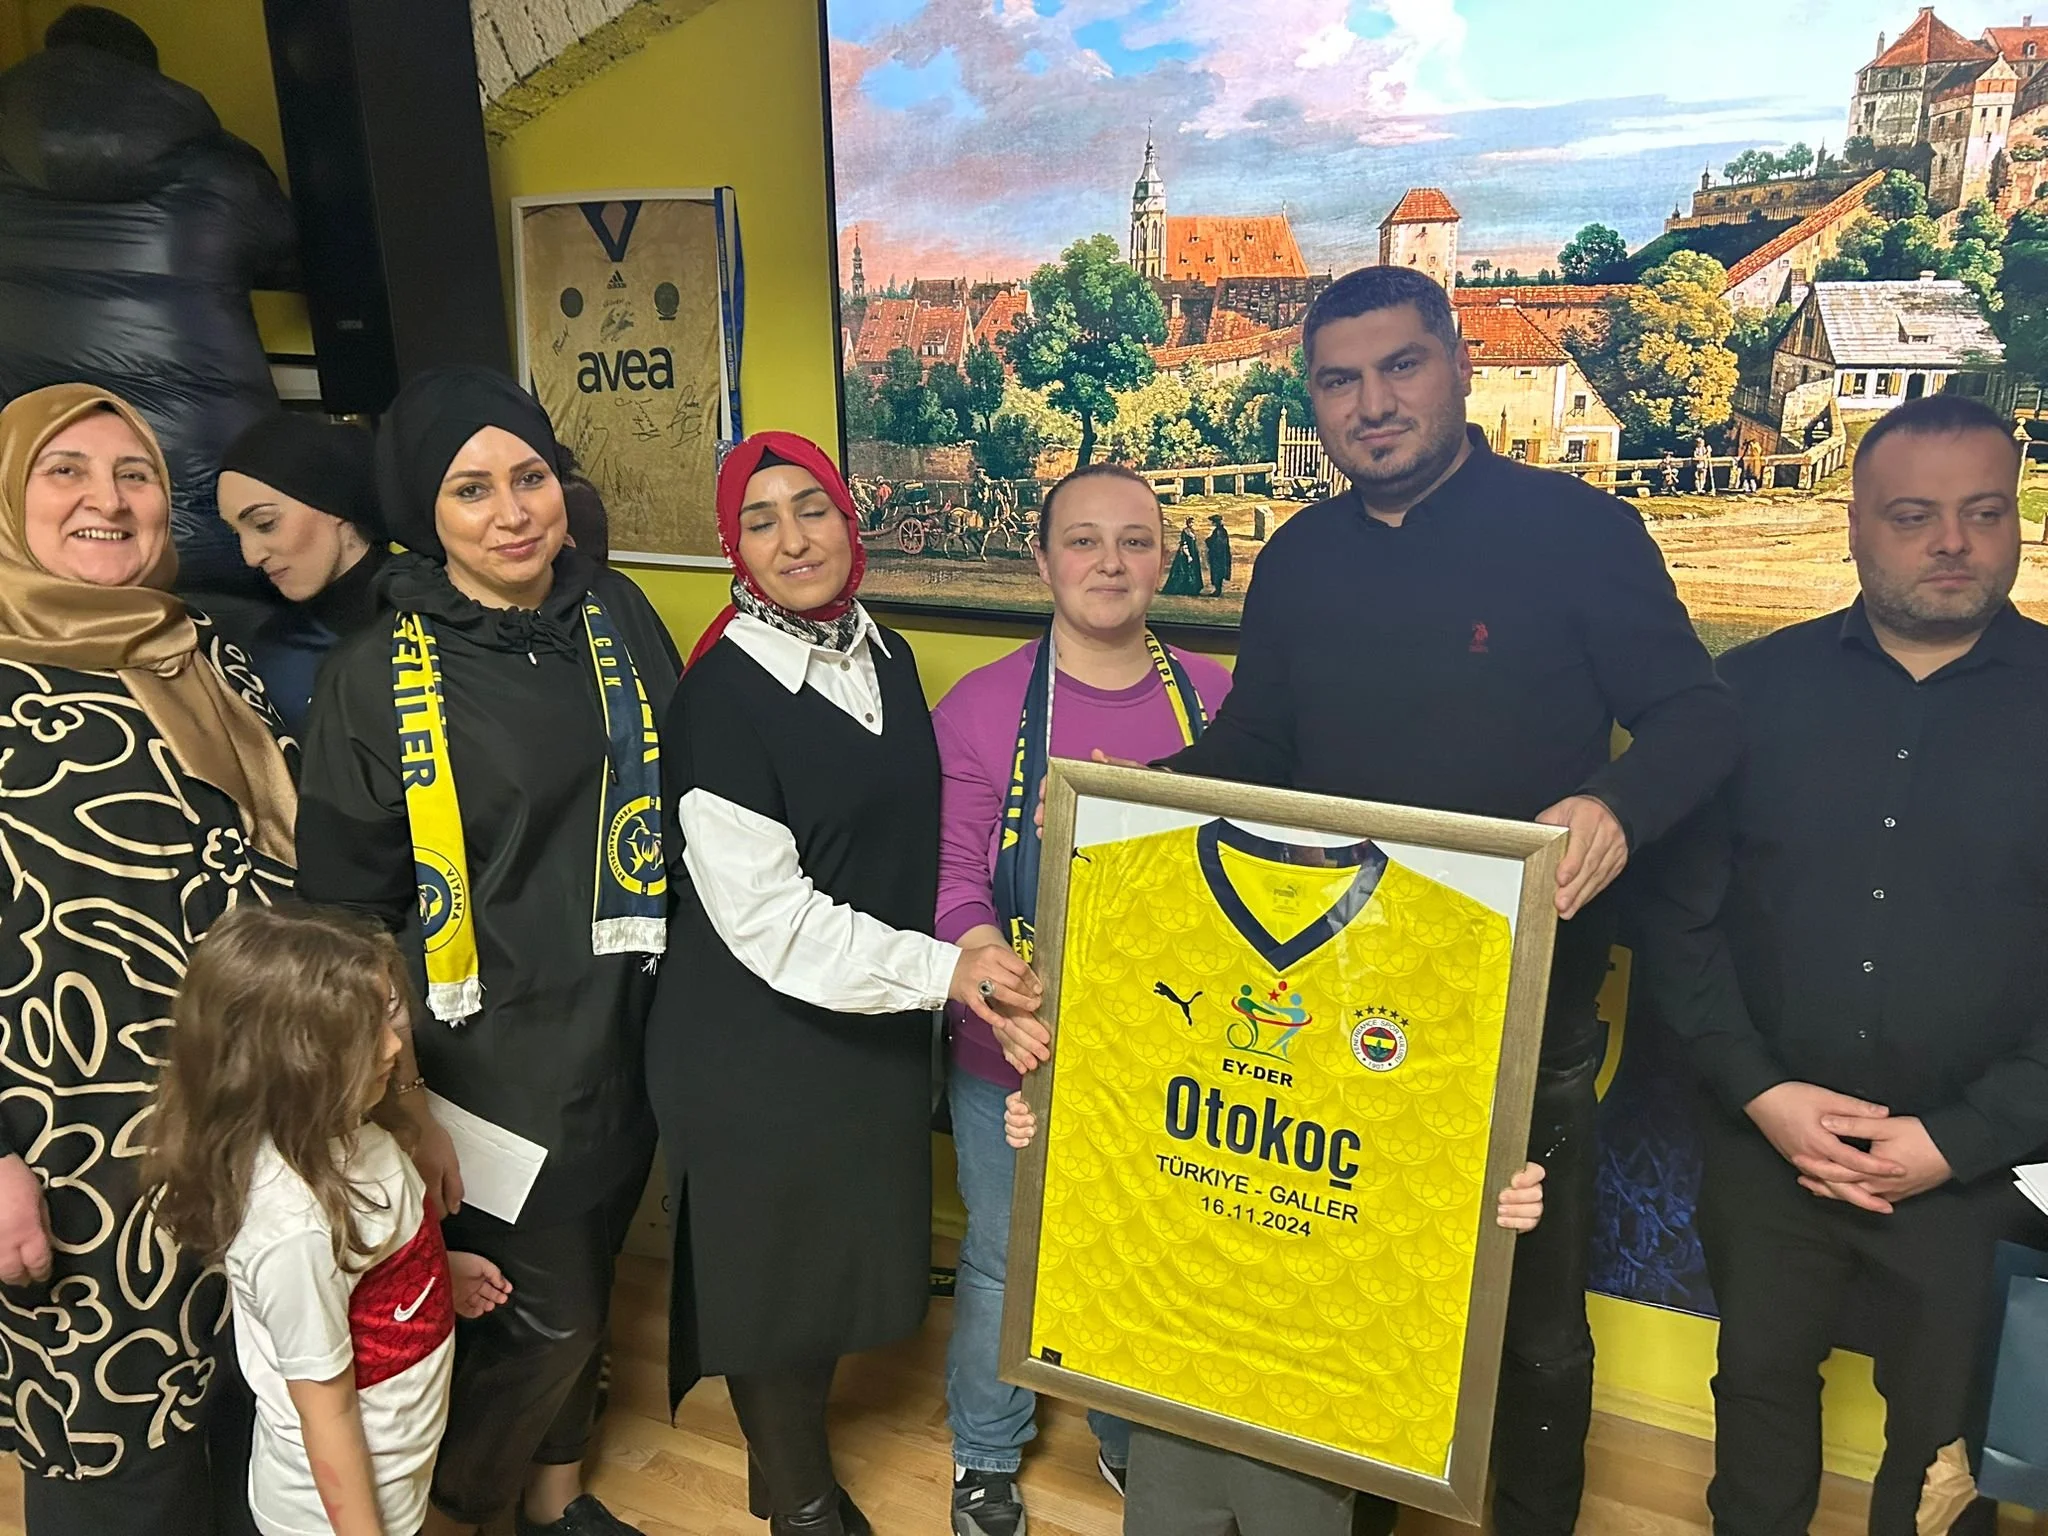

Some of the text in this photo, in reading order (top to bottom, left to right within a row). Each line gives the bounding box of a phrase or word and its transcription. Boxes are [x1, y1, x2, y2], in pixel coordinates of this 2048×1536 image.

[577, 347, 674, 393] avea
[593, 637, 622, 687] ÇOK
[446, 868, 463, 921] VİYANA
[1222, 1058, 1293, 1088] EY-DER
[1165, 1076, 1361, 1191] Otokoç
[1156, 1155, 1249, 1194] TÜRKIYE
[1269, 1186, 1358, 1224] GALLER
[1201, 1197, 1311, 1237] 16.11.2024
